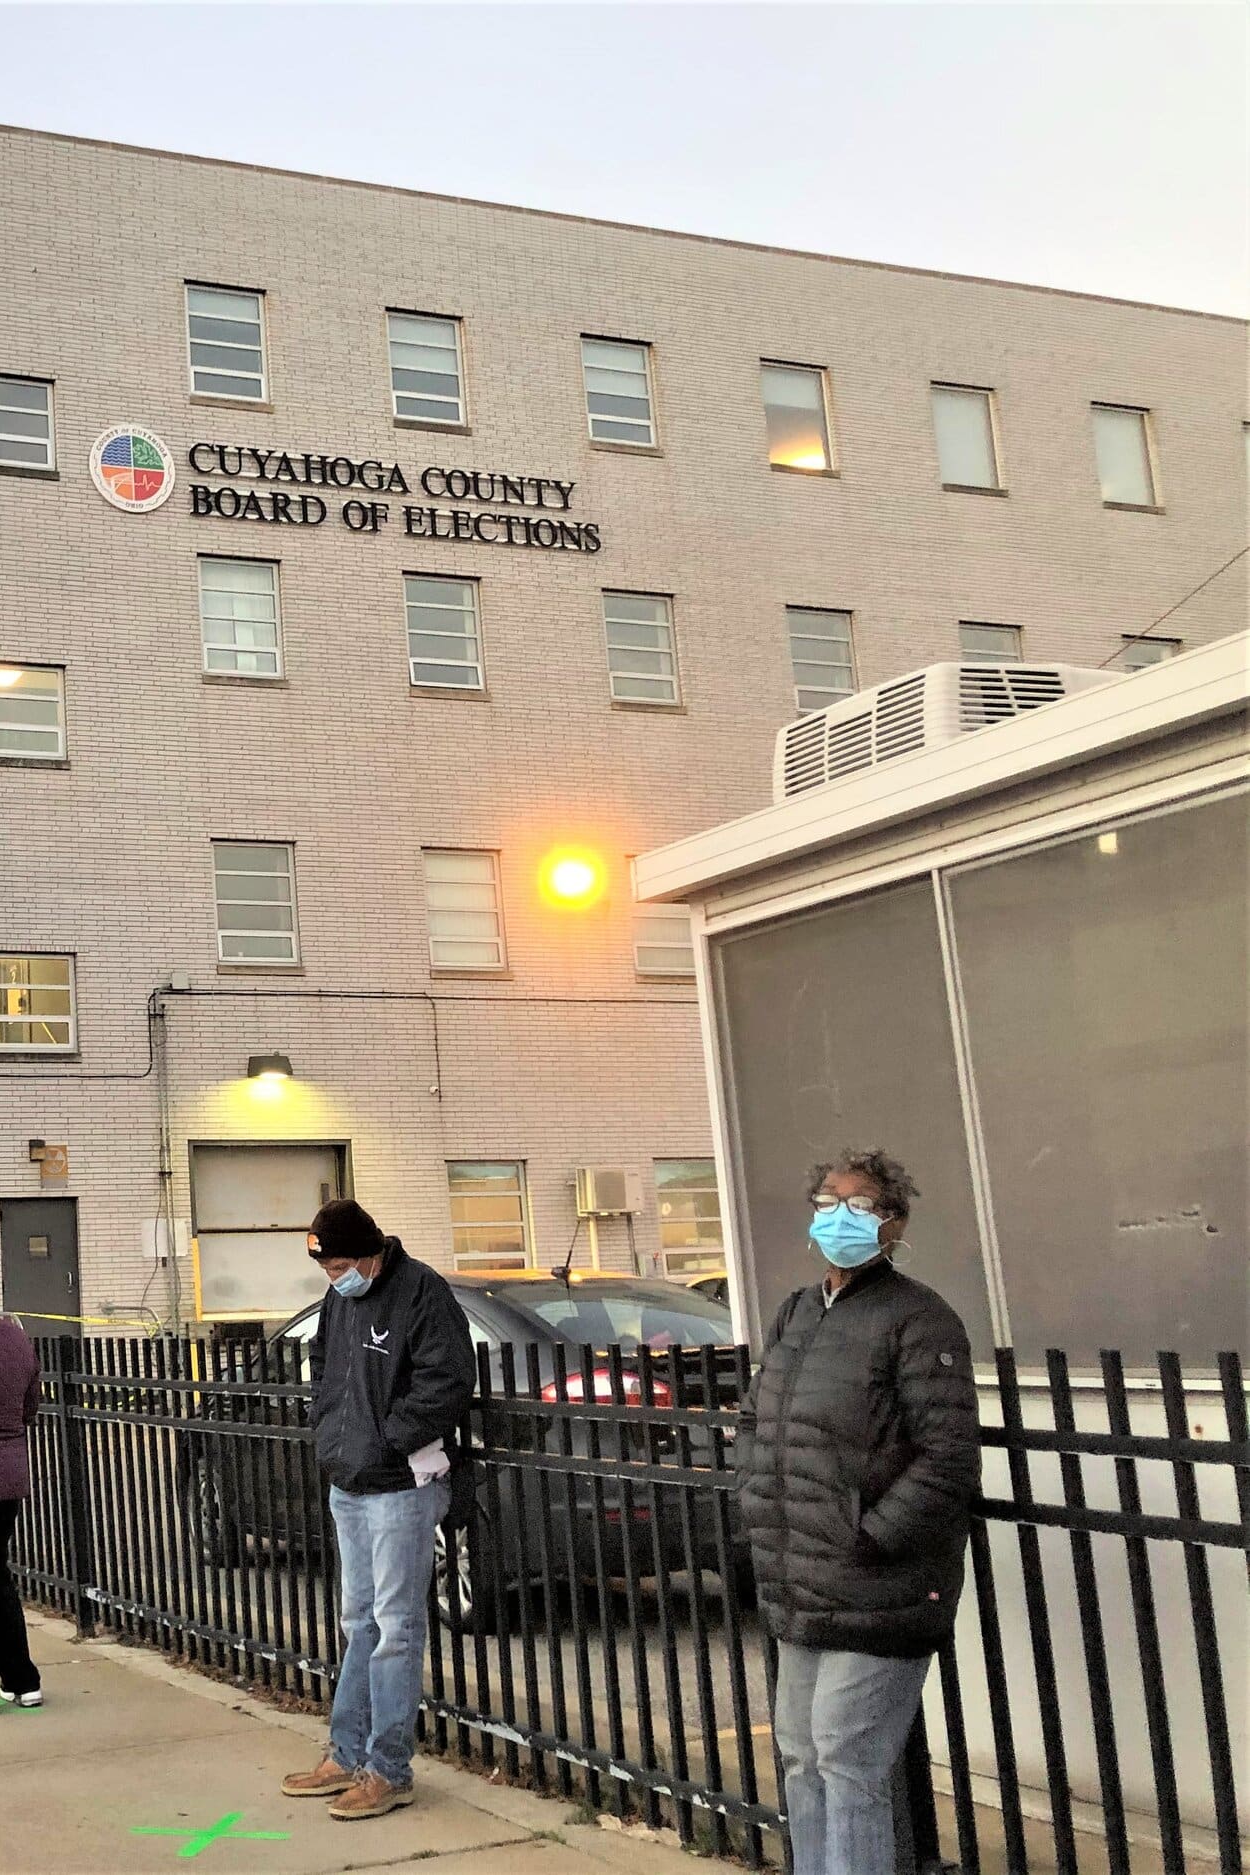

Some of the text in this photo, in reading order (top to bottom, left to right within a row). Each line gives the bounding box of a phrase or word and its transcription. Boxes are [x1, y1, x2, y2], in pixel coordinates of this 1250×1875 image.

[188, 442, 577, 510] CUYAHOGA COUNTY
[188, 484, 602, 553] BOARD OF ELECTIONS
